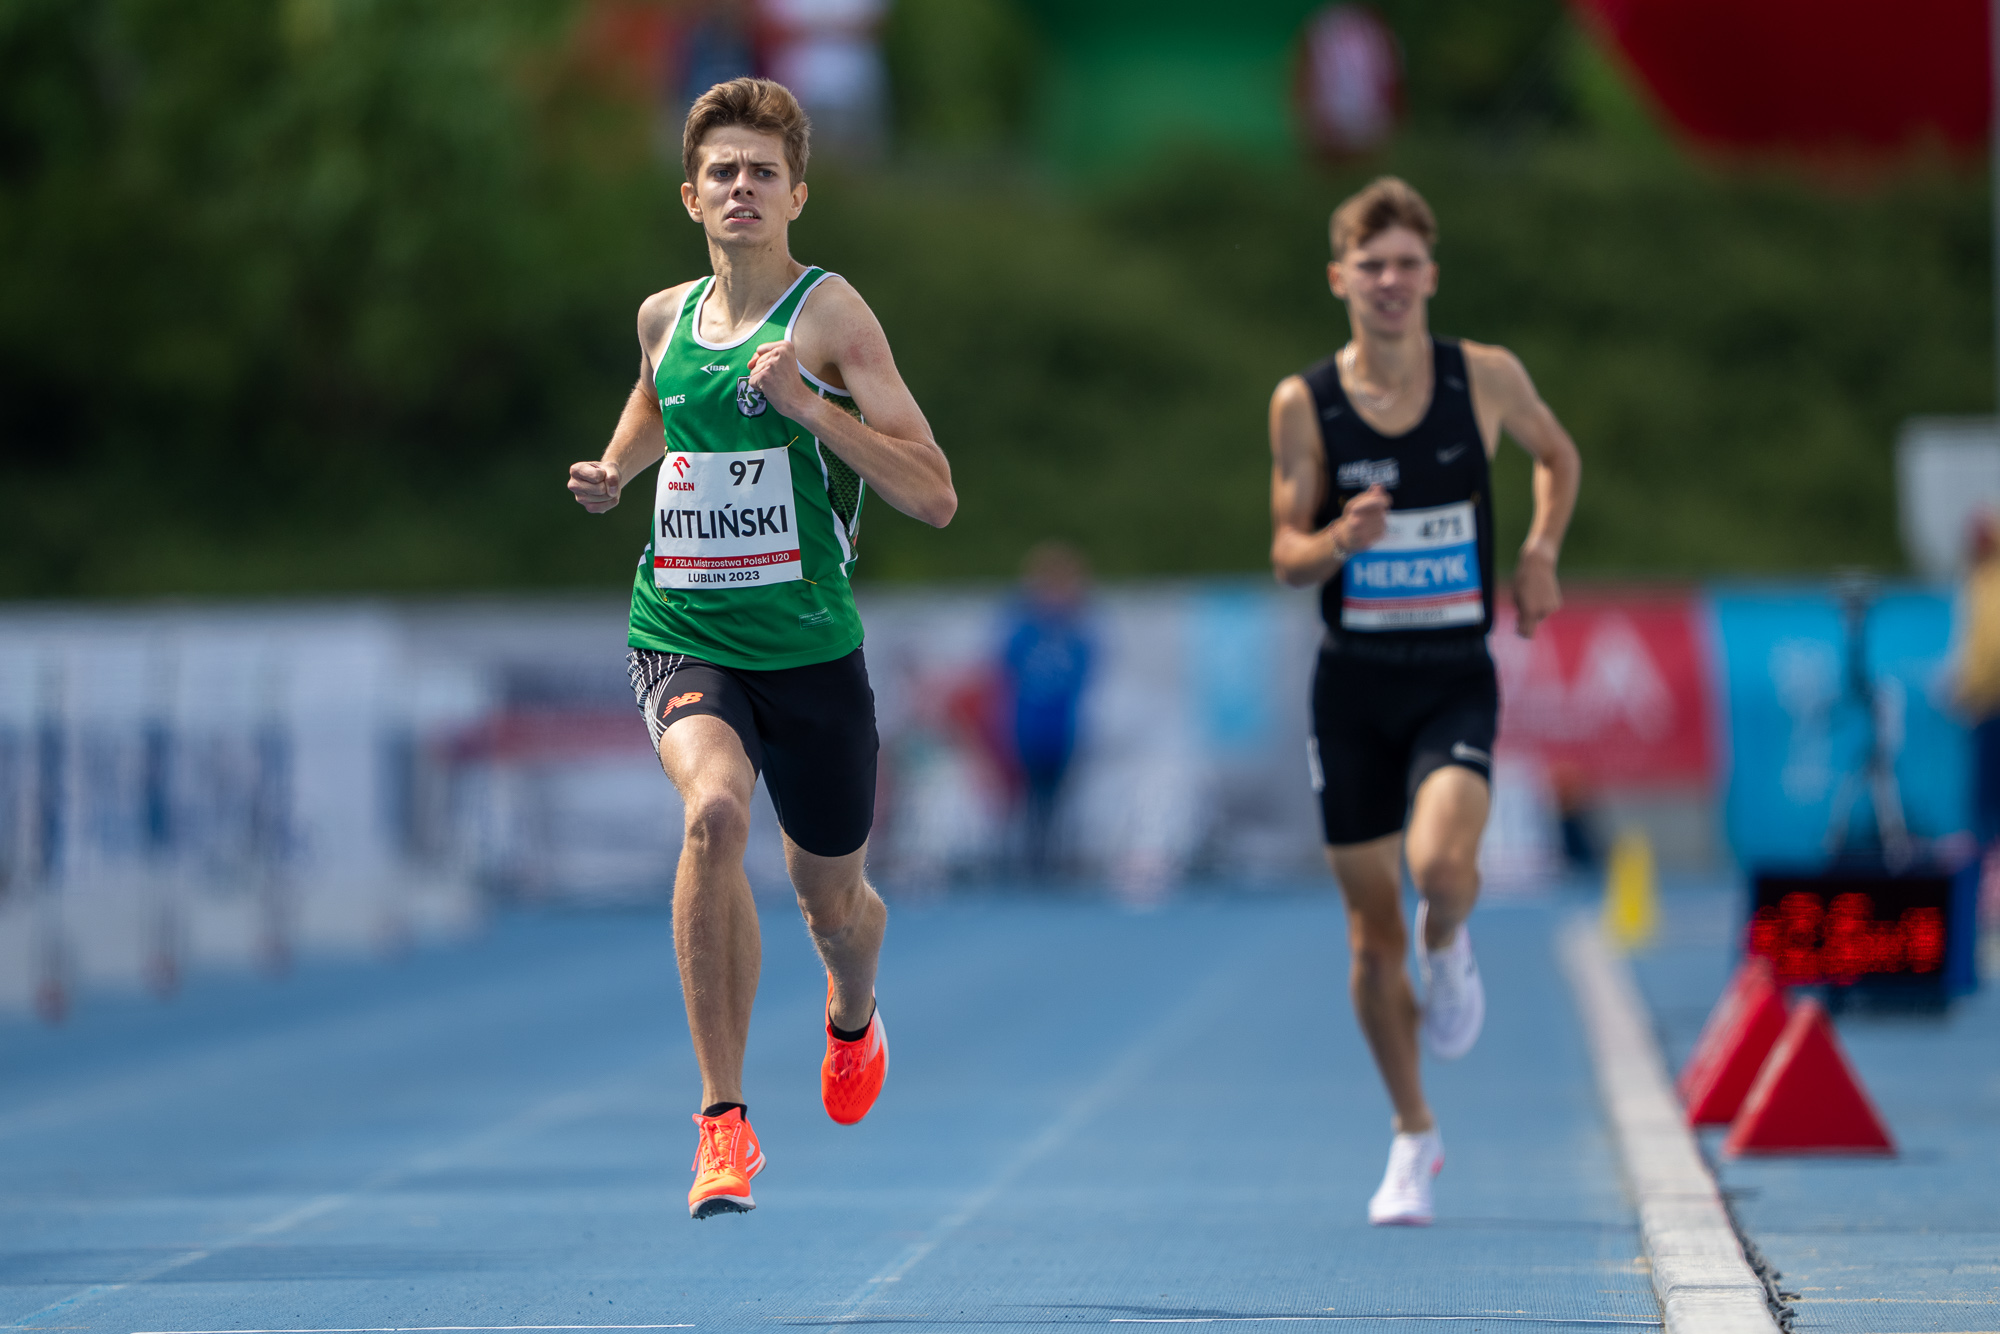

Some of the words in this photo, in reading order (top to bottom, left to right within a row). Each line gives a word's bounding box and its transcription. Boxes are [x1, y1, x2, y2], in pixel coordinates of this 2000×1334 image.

[664, 394, 686, 407] UMCS
[729, 458, 765, 486] 97
[668, 481, 695, 491] ORLEN
[660, 503, 788, 539] KITLIŃSKI
[1419, 514, 1463, 538] 471
[663, 558, 675, 567] 77.
[675, 559, 692, 567] PZLA
[693, 559, 742, 568] Mistrzostwa
[743, 554, 770, 566] Polski
[771, 552, 790, 563] U20
[688, 573, 726, 583] LUBLIN
[728, 570, 760, 582] 2023
[1353, 553, 1469, 588] HERZYK
